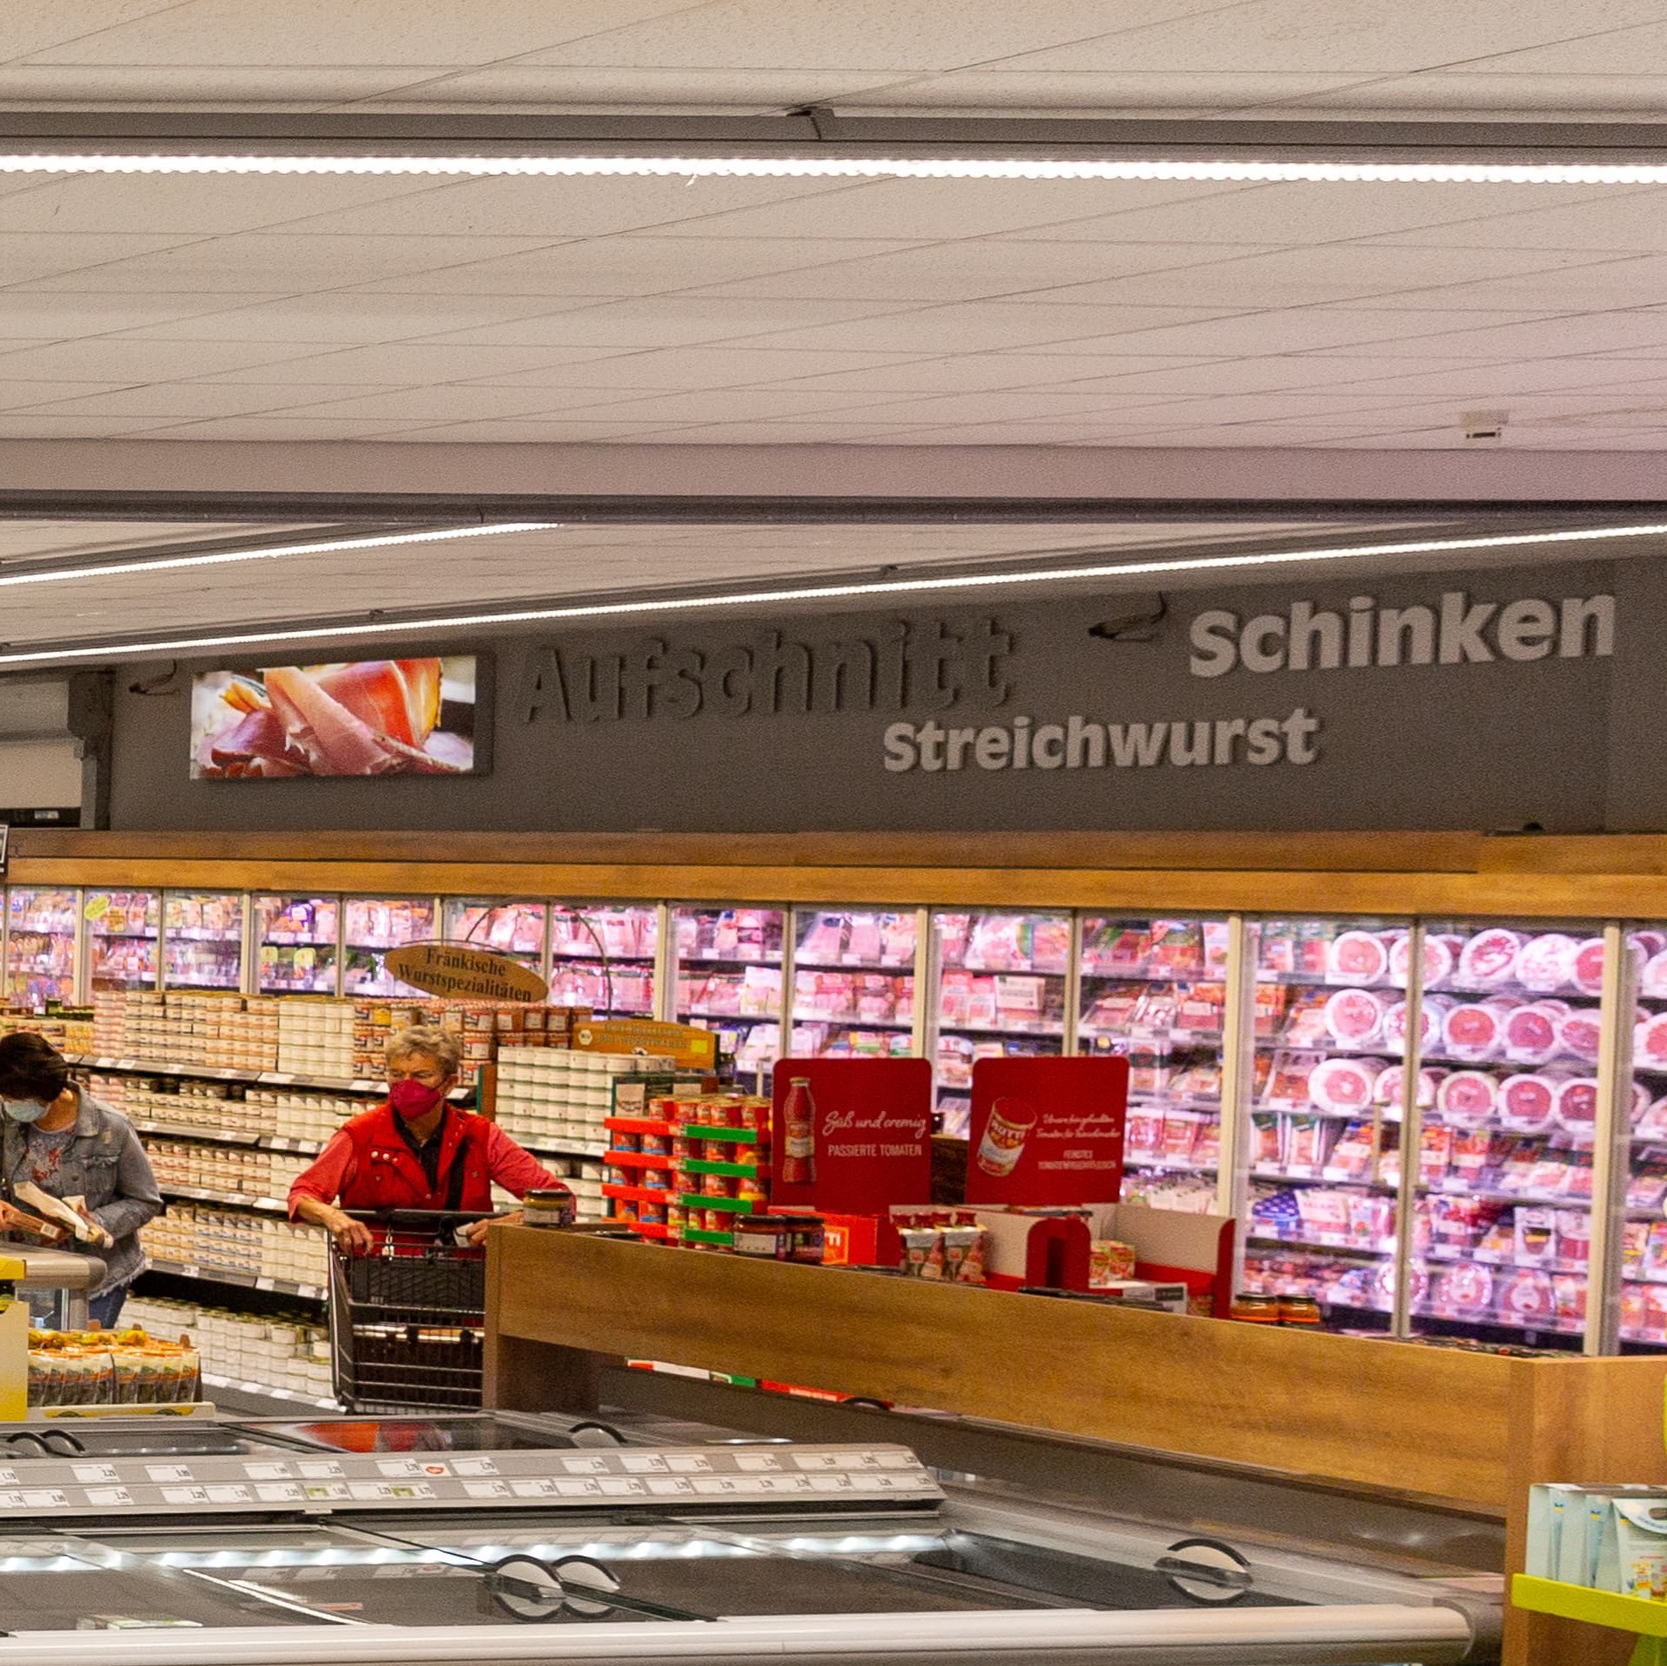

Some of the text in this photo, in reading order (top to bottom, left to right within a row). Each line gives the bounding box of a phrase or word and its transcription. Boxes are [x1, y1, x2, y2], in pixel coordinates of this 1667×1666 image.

[1189, 593, 1617, 679] Schinken
[525, 617, 1019, 726] Aufschnitt
[882, 708, 1319, 773] Streichwurst
[397, 962, 532, 1001] Wurstspezialitäten
[426, 947, 506, 977] Fränkische
[828, 1143, 923, 1157] PASSIERTE TOMATEN
